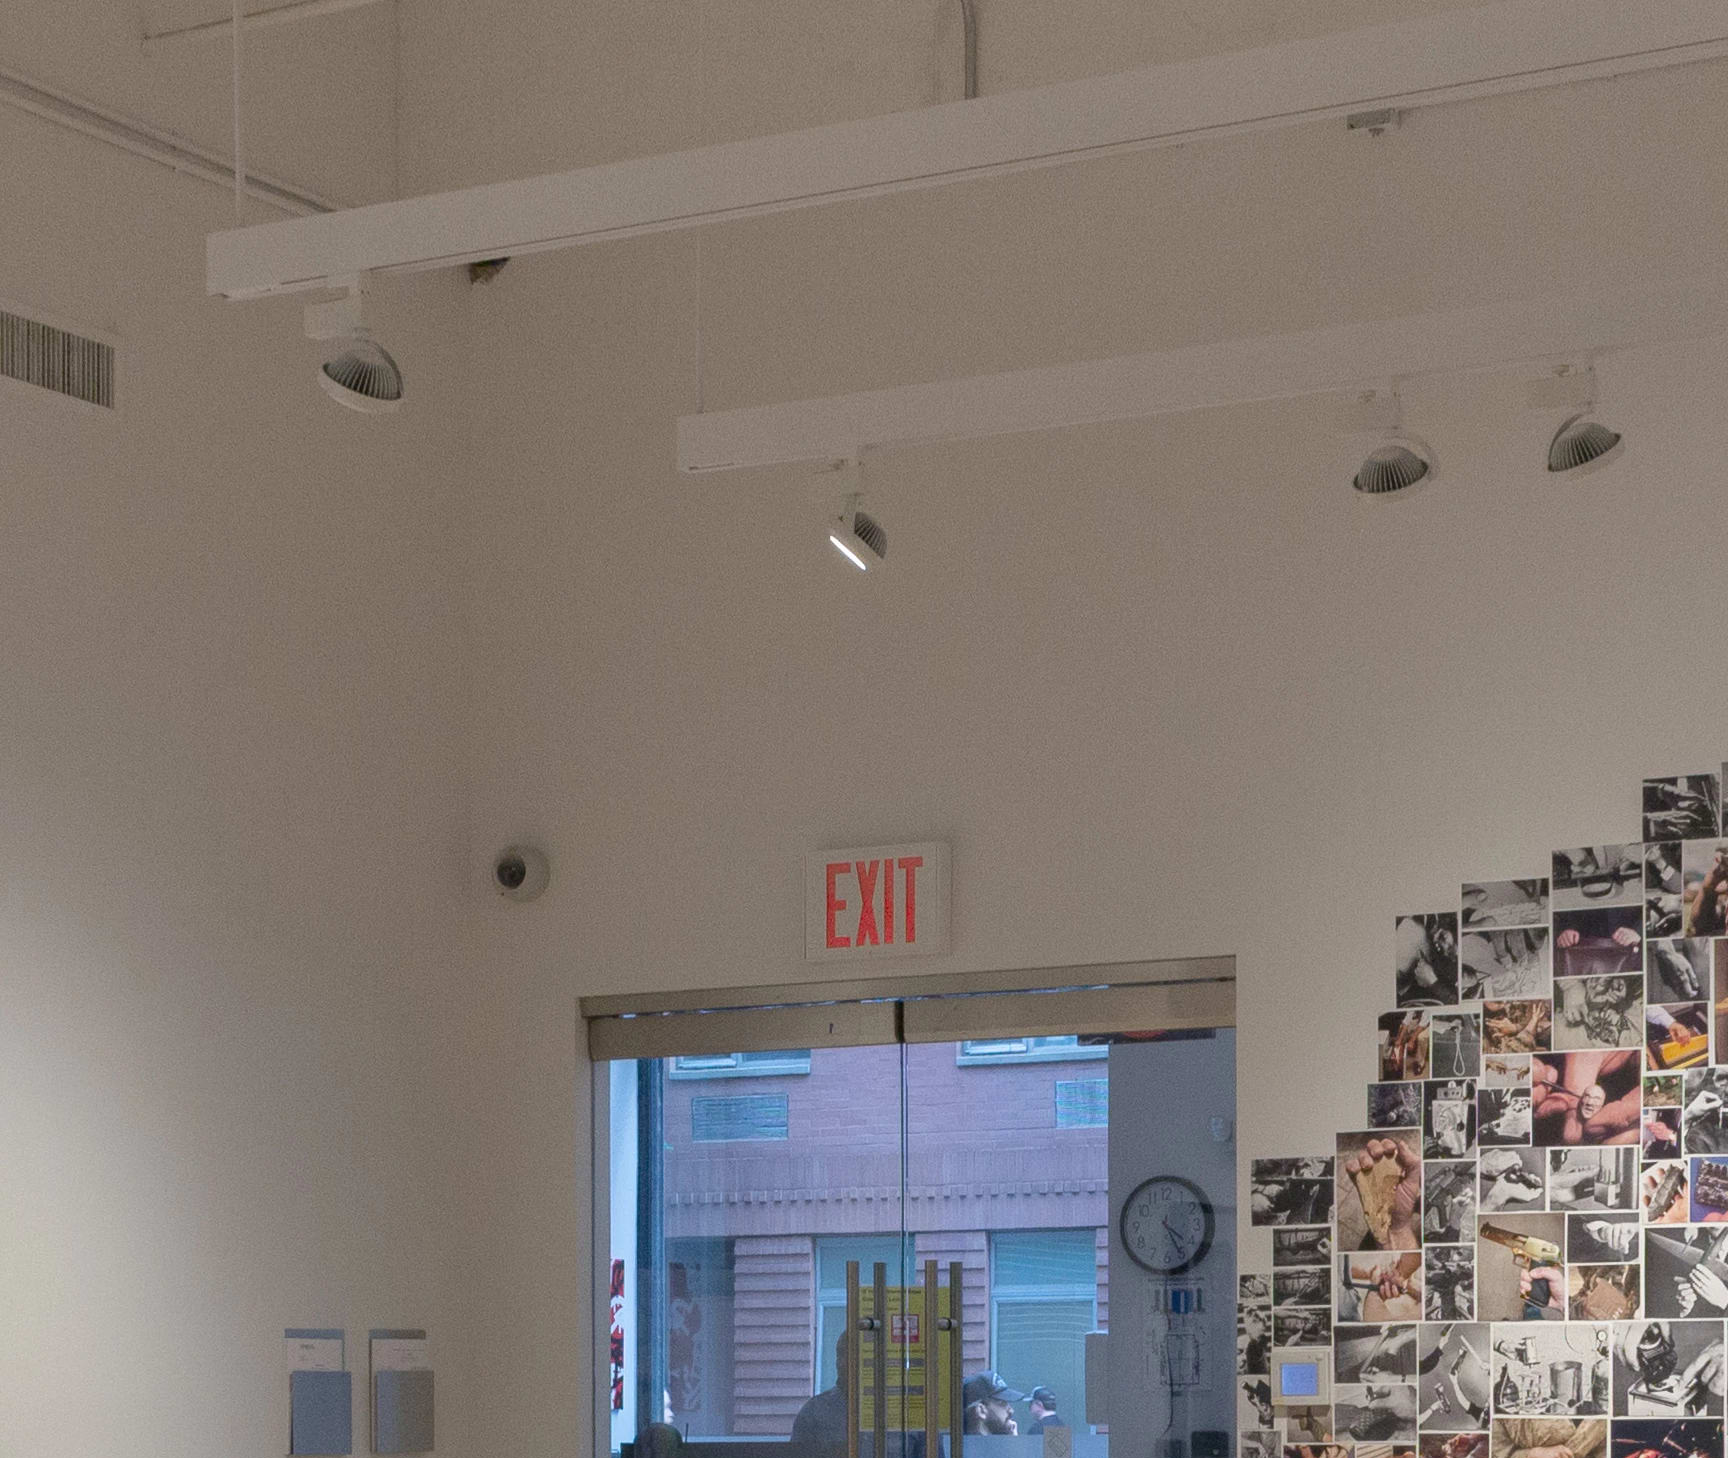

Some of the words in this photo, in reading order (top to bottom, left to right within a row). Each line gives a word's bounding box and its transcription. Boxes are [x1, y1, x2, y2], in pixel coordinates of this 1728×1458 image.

[826, 856, 923, 949] EXIT
[1148, 1191, 1157, 1205] 11
[1161, 1187, 1171, 1201] 12
[1138, 1204, 1150, 1217] 10
